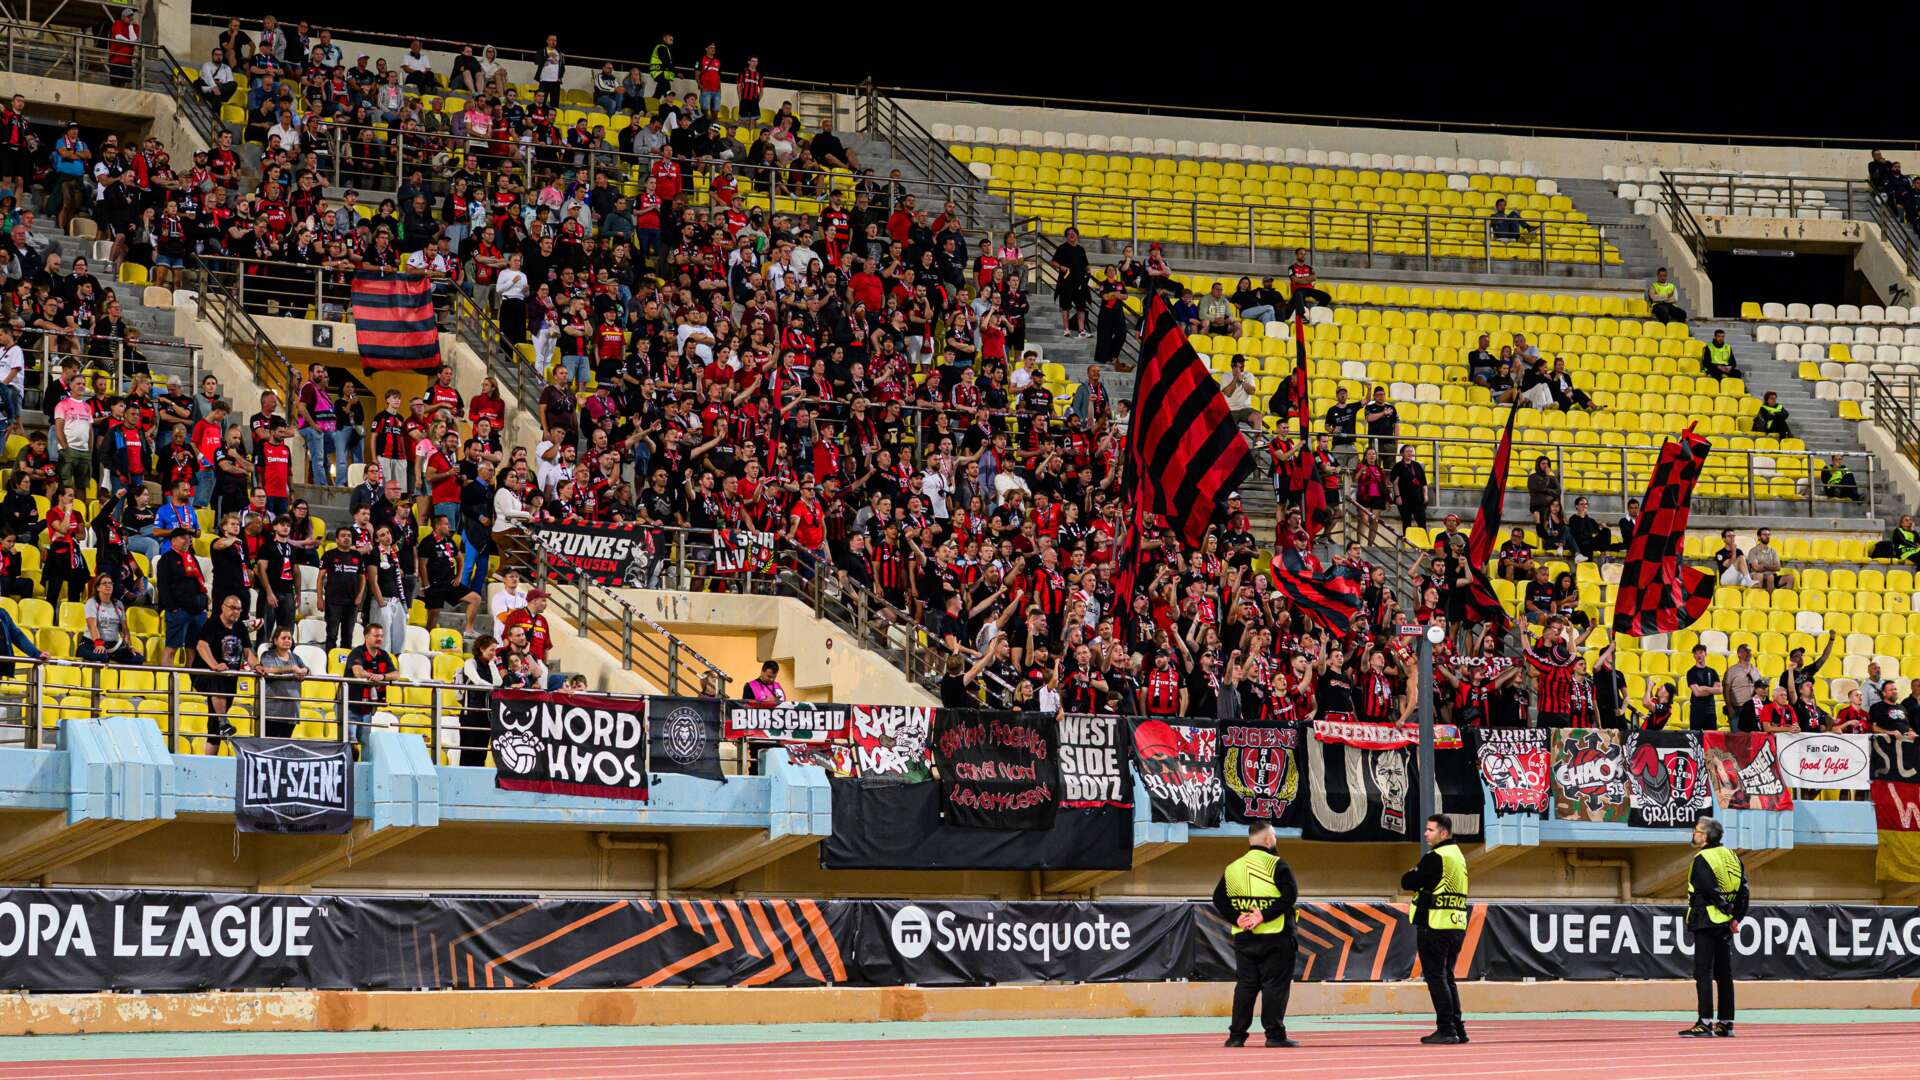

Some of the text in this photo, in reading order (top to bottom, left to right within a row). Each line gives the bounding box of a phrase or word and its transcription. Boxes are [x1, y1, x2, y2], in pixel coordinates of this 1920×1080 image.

[537, 530, 632, 560] SKUNKS
[1492, 656, 1513, 667] 513
[541, 703, 642, 749] NORD
[731, 709, 845, 731] BURSCHEID
[1058, 717, 1117, 747] WEST
[1480, 728, 1548, 743] FARBEN
[1806, 744, 1840, 753] Fan Club
[1059, 745, 1120, 776] SIDE
[1246, 760, 1278, 772] BAYER
[248, 754, 344, 804] LEV-SZENE
[1063, 774, 1124, 802] BOYZ
[1253, 786, 1272, 796] 04
[1243, 797, 1289, 818] LEV
[113, 904, 314, 957] LEAGUE
[936, 910, 1131, 962] Swissquote
[1529, 913, 1641, 955] UEFA
[1653, 915, 1817, 957] EUOPA
